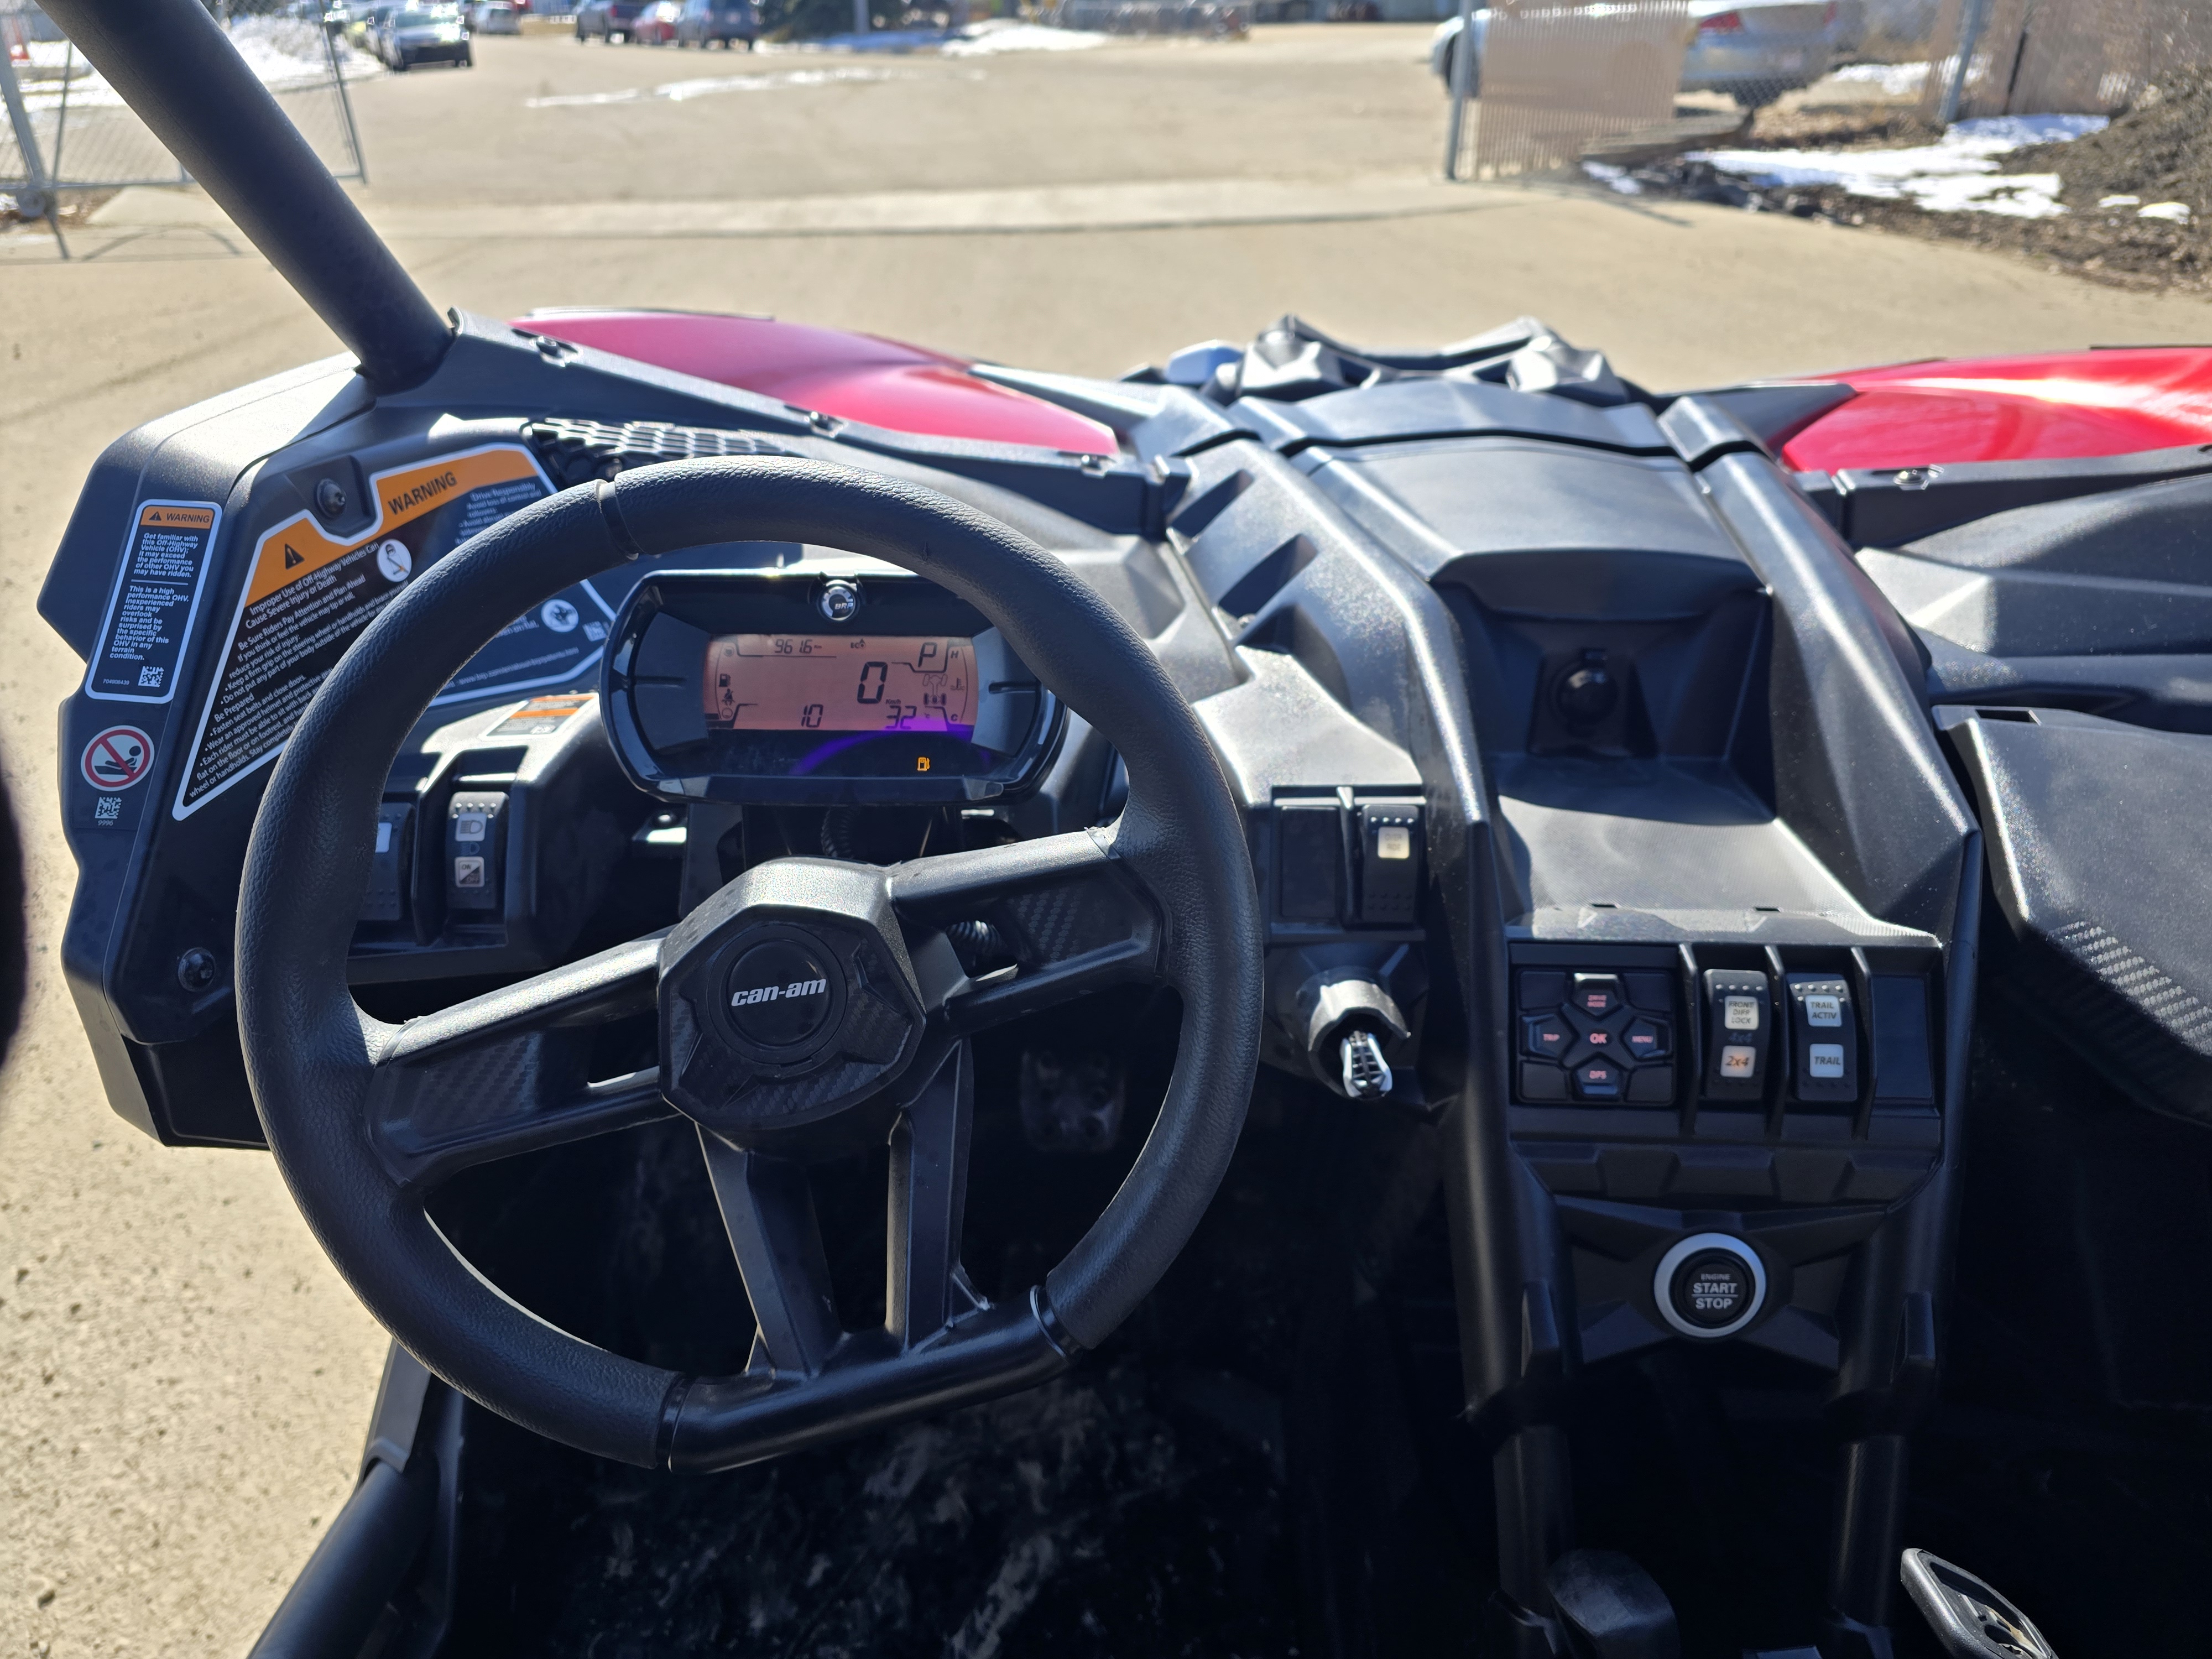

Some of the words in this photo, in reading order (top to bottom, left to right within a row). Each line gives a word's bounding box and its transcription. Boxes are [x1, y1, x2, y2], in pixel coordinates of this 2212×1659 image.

[388, 471, 457, 515] WARNING
[166, 513, 210, 523] WARNING
[156, 540, 198, 549] Off-Highway
[249, 593, 281, 615] Improper
[281, 586, 295, 597] Use
[295, 580, 303, 591] of
[302, 561, 341, 586] Off-Highway
[340, 550, 366, 566] Vehicles
[364, 542, 379, 553] Can
[238, 641, 248, 650] Be
[247, 632, 263, 645] Sure
[262, 621, 283, 636] Riders
[281, 614, 294, 625] Pay
[294, 599, 322, 618] Attention
[322, 591, 334, 603] and
[333, 586, 347, 596] Plan
[346, 573, 366, 589] Ahead
[245, 611, 267, 628] Cause
[266, 600, 290, 617] Severe
[288, 589, 309, 604] Injury
[309, 586, 317, 594] or
[316, 575, 336, 590] Death
[237, 653, 243, 662] If
[243, 648, 255, 661] you
[254, 639, 271, 652] think
[276, 627, 289, 639] feel
[288, 623, 299, 633] the
[299, 612, 318, 627] vehicle
[318, 606, 330, 616] may
[329, 601, 338, 609] tip
[229, 663, 251, 679] reduce
[249, 654, 264, 668] your
[264, 648, 275, 658] risk
[274, 643, 281, 652] of
[918, 642, 937, 667] P
[857, 661, 888, 704] 0
[206, 736, 224, 749] Wear
[225, 731, 233, 739] an
[233, 711, 262, 734] approved
[260, 698, 282, 716] helmet
[281, 690, 294, 703] and
[293, 675, 321, 697] protective
[212, 719, 233, 735] Fasten
[233, 709, 247, 722] seat
[245, 701, 262, 714] belts
[261, 692, 273, 705] and
[273, 684, 288, 697] close
[288, 674, 306, 688] doors.
[214, 712, 225, 722] Be
[223, 692, 254, 716] Prepared
[801, 704, 823, 728] 10
[886, 705, 917, 729] 32
[202, 752, 219, 765] Each
[218, 742, 233, 755] rider
[233, 731, 249, 745] must
[248, 726, 258, 734] be
[258, 717, 271, 729] able
[285, 700, 299, 711] with
[298, 691, 312, 703] back
[196, 769, 208, 780] flat
[208, 764, 218, 773] on
[217, 757, 228, 767] the
[227, 747, 243, 759] floor
[250, 736, 259, 745] on
[283, 712, 295, 724] and
[189, 780, 209, 797] wheel
[209, 776, 216, 784] or
[249, 744, 263, 757] Stay
[732, 978, 826, 1006] can-am
[1589, 1033, 1607, 1044] OK
[1725, 1056, 1749, 1066] 2x4
[1814, 1056, 1841, 1065] TRAIL
[1693, 1282, 1738, 1294] START
[1695, 1298, 1733, 1310] STOP
